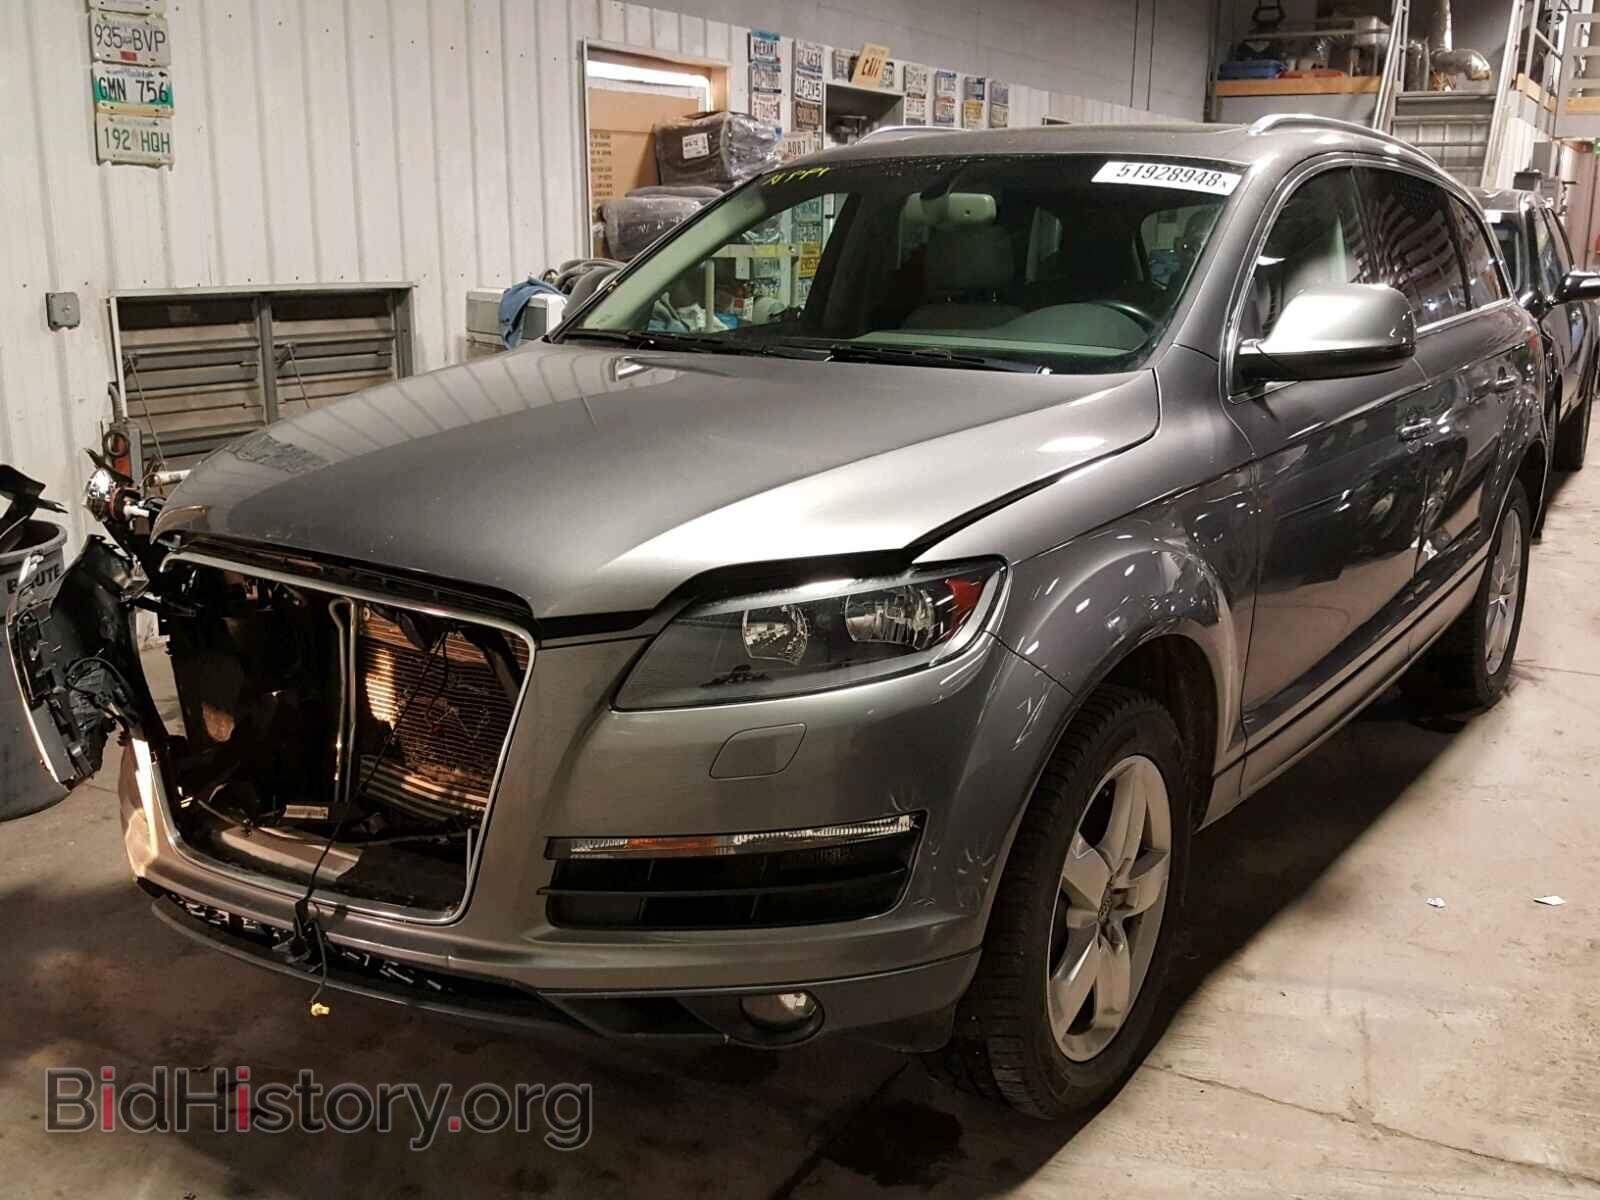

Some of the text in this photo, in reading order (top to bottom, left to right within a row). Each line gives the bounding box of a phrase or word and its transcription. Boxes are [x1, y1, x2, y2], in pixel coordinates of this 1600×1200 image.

[132, 28, 166, 52] BVP
[99, 76, 169, 103] GMN 756
[104, 127, 171, 154] 192 HQH
[1116, 163, 1223, 188] 51928948
[7, 563, 61, 594] BUTE
